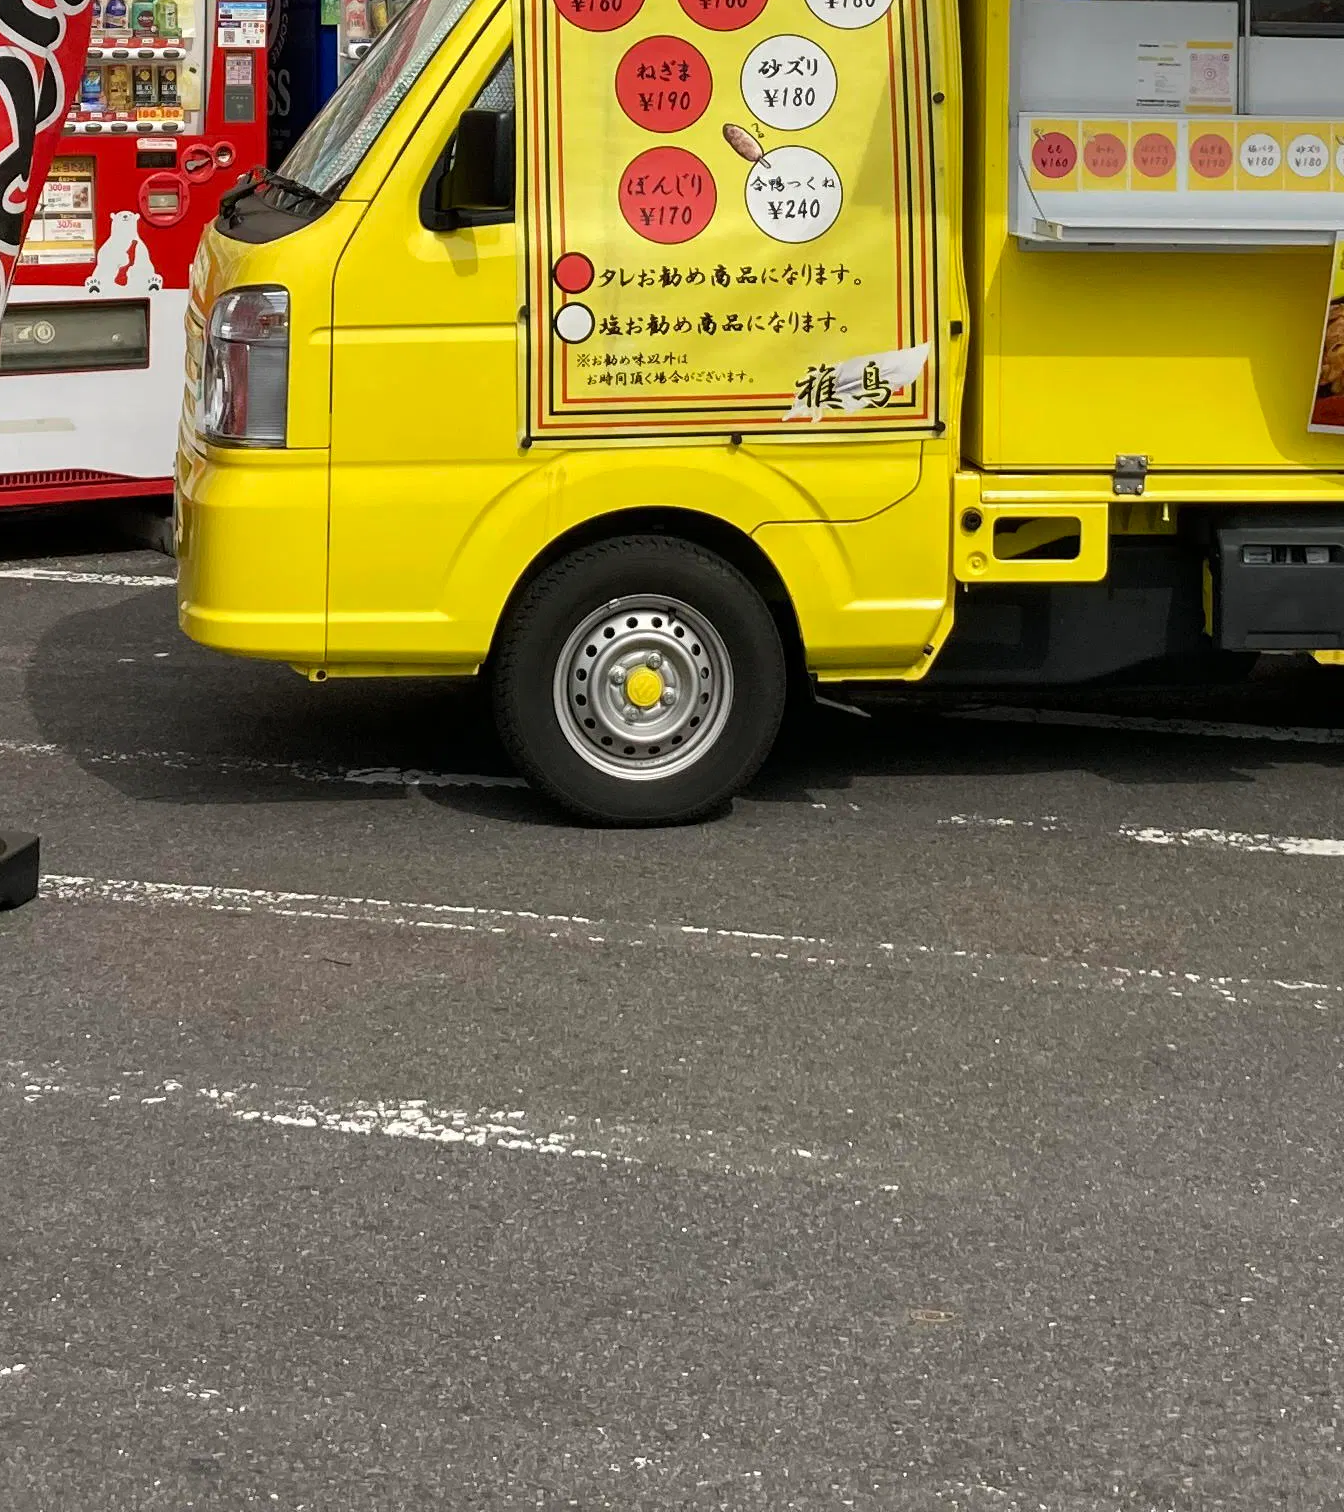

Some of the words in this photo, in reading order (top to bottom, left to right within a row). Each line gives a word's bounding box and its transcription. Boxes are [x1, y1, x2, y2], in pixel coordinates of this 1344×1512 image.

[636, 60, 692, 82] ねぎま
[757, 55, 818, 77] 砂ズリ
[638, 91, 691, 111] ¥190
[763, 87, 816, 107] ¥180
[1041, 159, 1068, 168] ¥160
[1247, 157, 1274, 167] ¥180
[1295, 157, 1322, 168] ¥180
[627, 174, 703, 197] ぼんじり
[639, 205, 692, 226] ¥170
[768, 199, 820, 219] ¥240
[597, 263, 862, 288] タレお勧め商品になります。
[598, 311, 848, 336] 塩お勧め商品になります。
